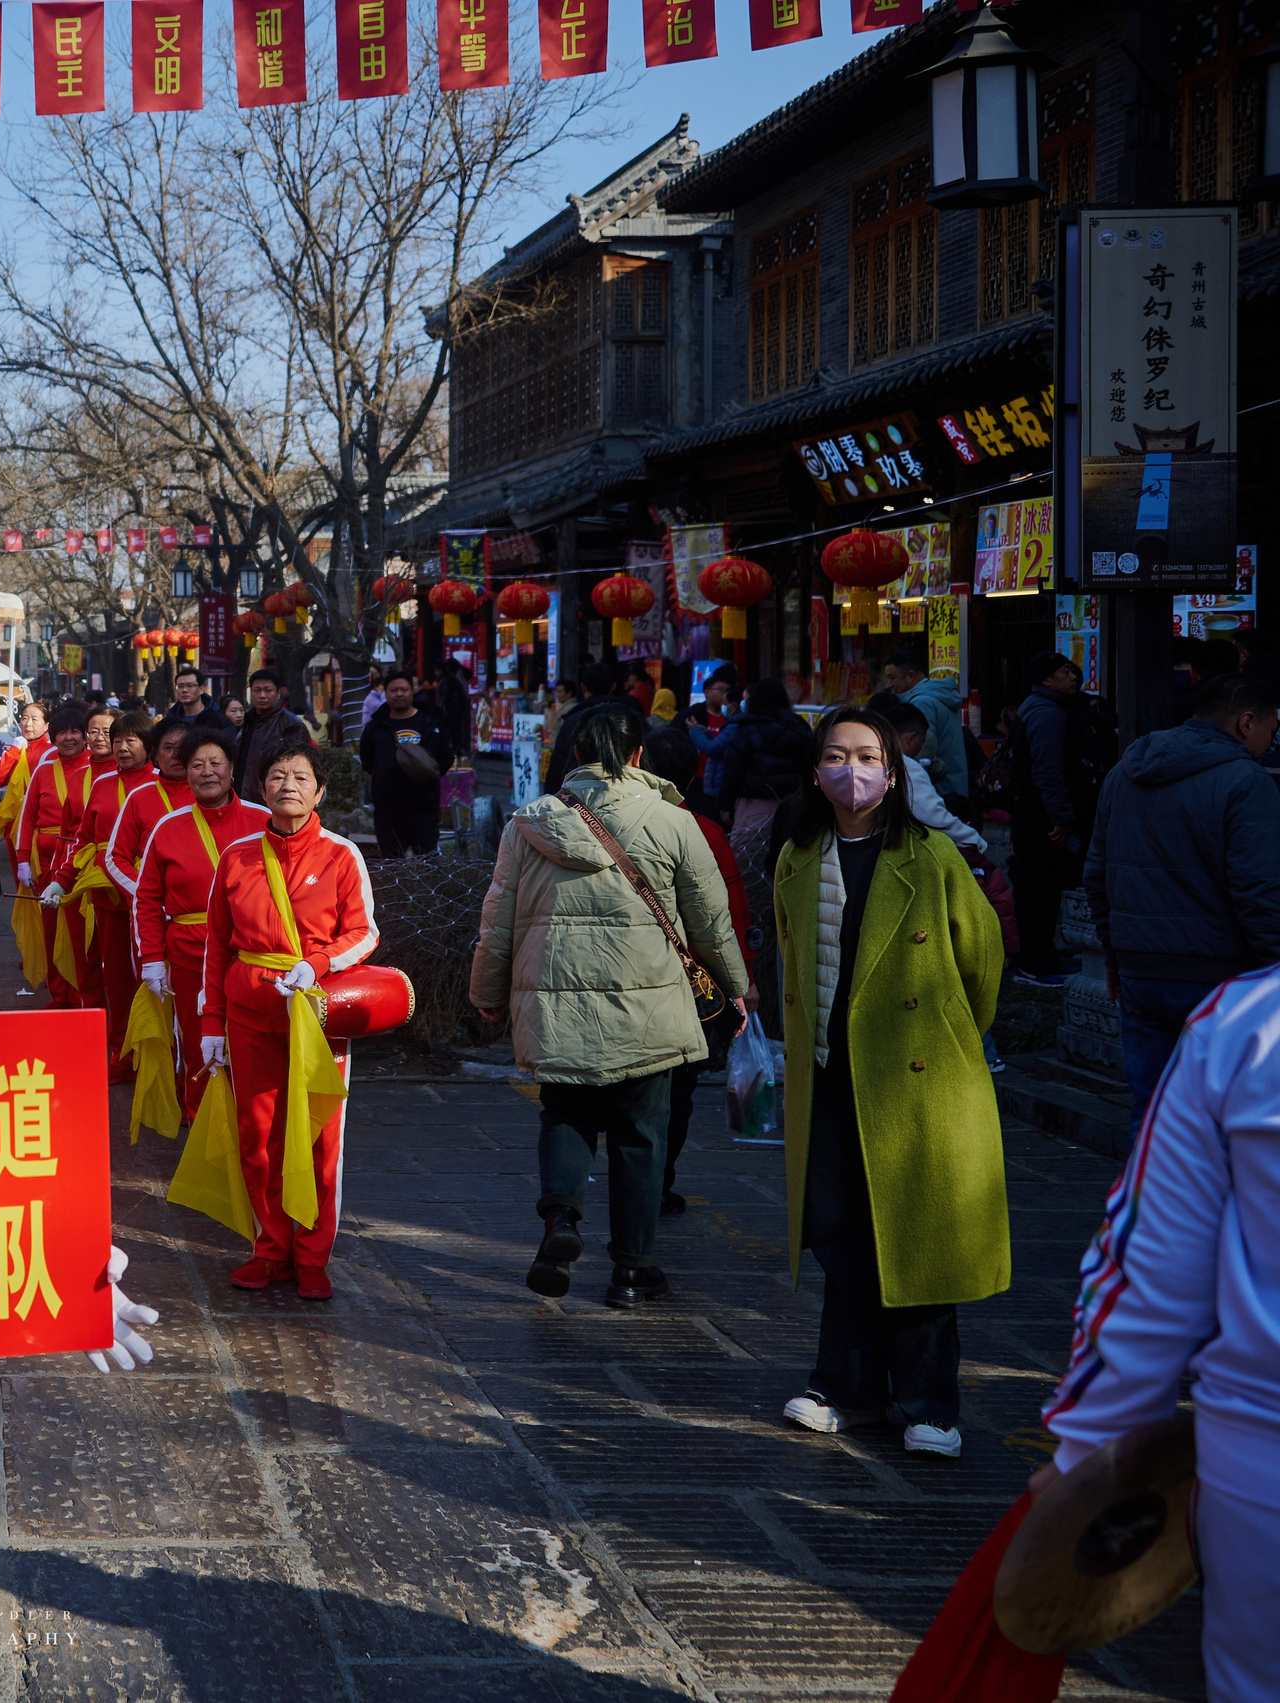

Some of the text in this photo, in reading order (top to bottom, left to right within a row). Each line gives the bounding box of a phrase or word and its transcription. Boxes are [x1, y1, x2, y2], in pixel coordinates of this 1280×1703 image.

[55, 17, 83, 97] 民主
[154, 14, 181, 95] 文明
[255, 8, 284, 89] 和谐
[359, 0, 386, 82] 自由
[459, 0, 487, 73] 平等
[1190, 261, 1207, 330] 青州古城
[1141, 263, 1176, 411] 奇幻侏罗纪
[1110, 368, 1127, 423] 欢迎您
[641, 886, 681, 948] LUODENGDAISHU
